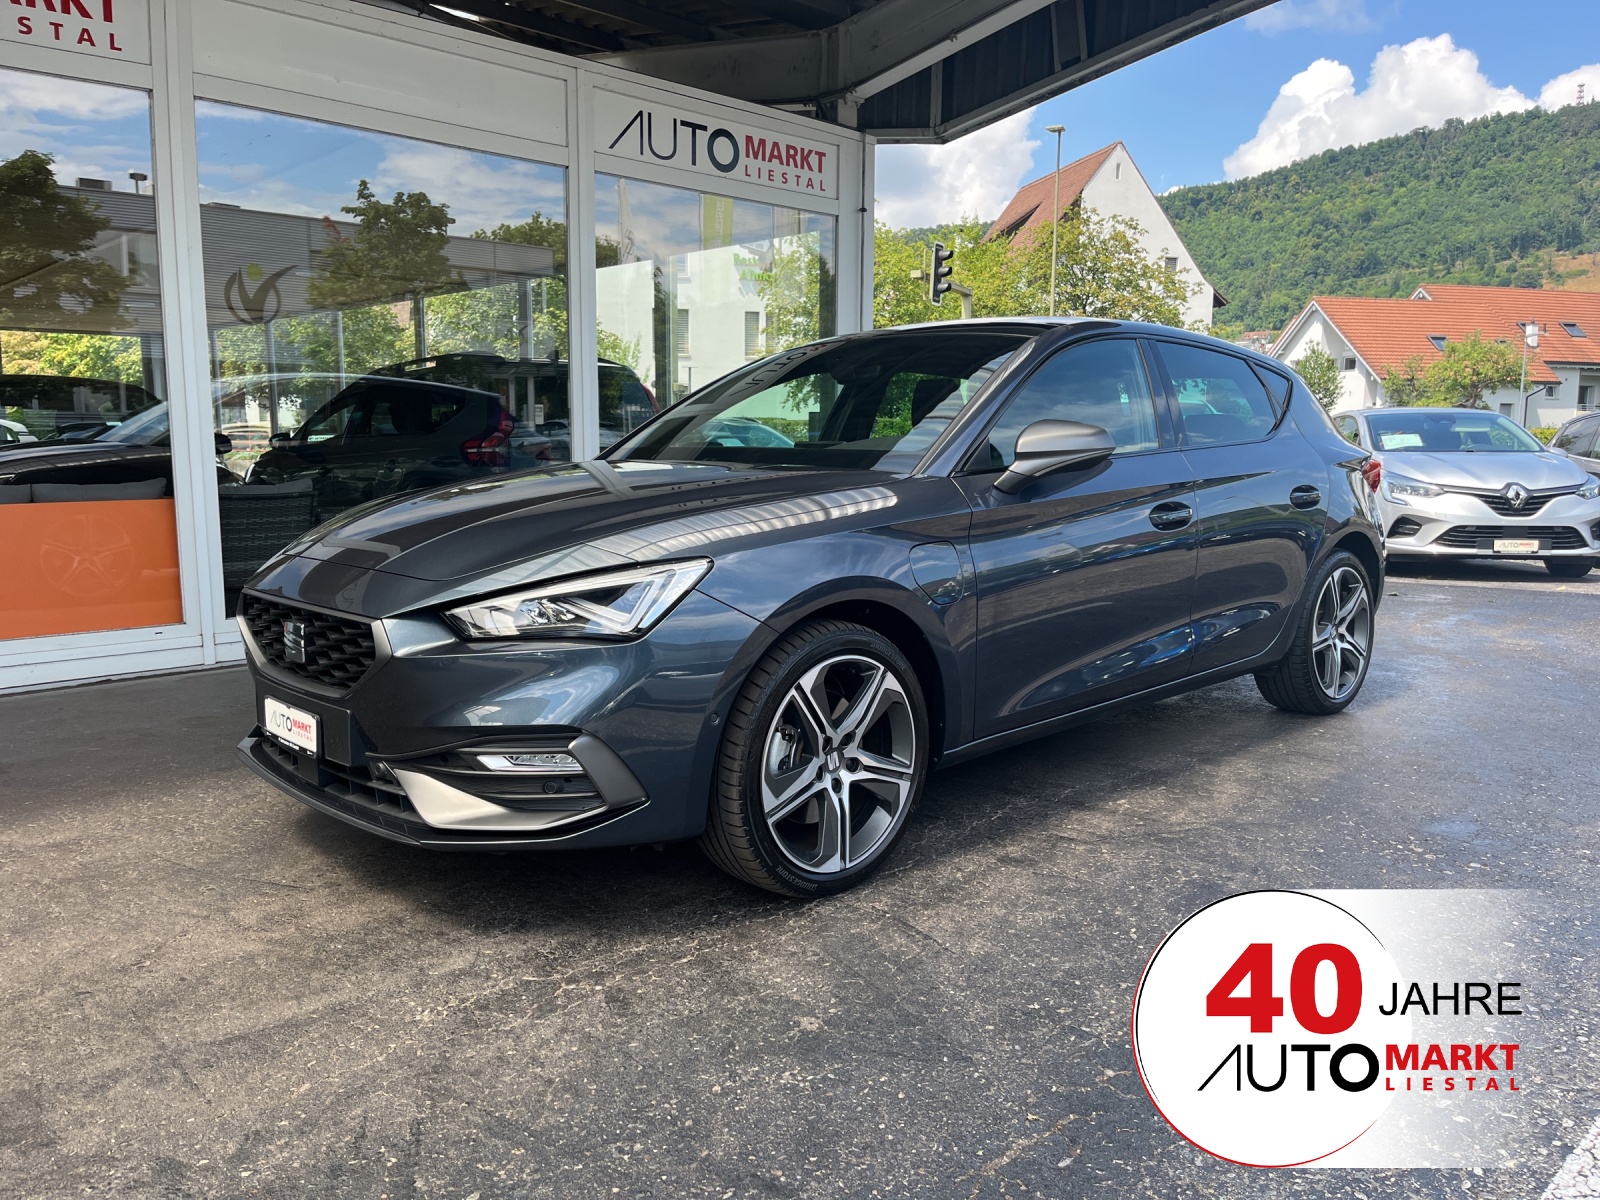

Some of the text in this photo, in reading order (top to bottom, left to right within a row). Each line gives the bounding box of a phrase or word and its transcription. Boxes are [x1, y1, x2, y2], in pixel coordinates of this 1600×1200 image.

[608, 110, 827, 174] AUTO MARKT
[744, 164, 826, 192] LIESTAL
[270, 709, 312, 735] AUTO MARKT
